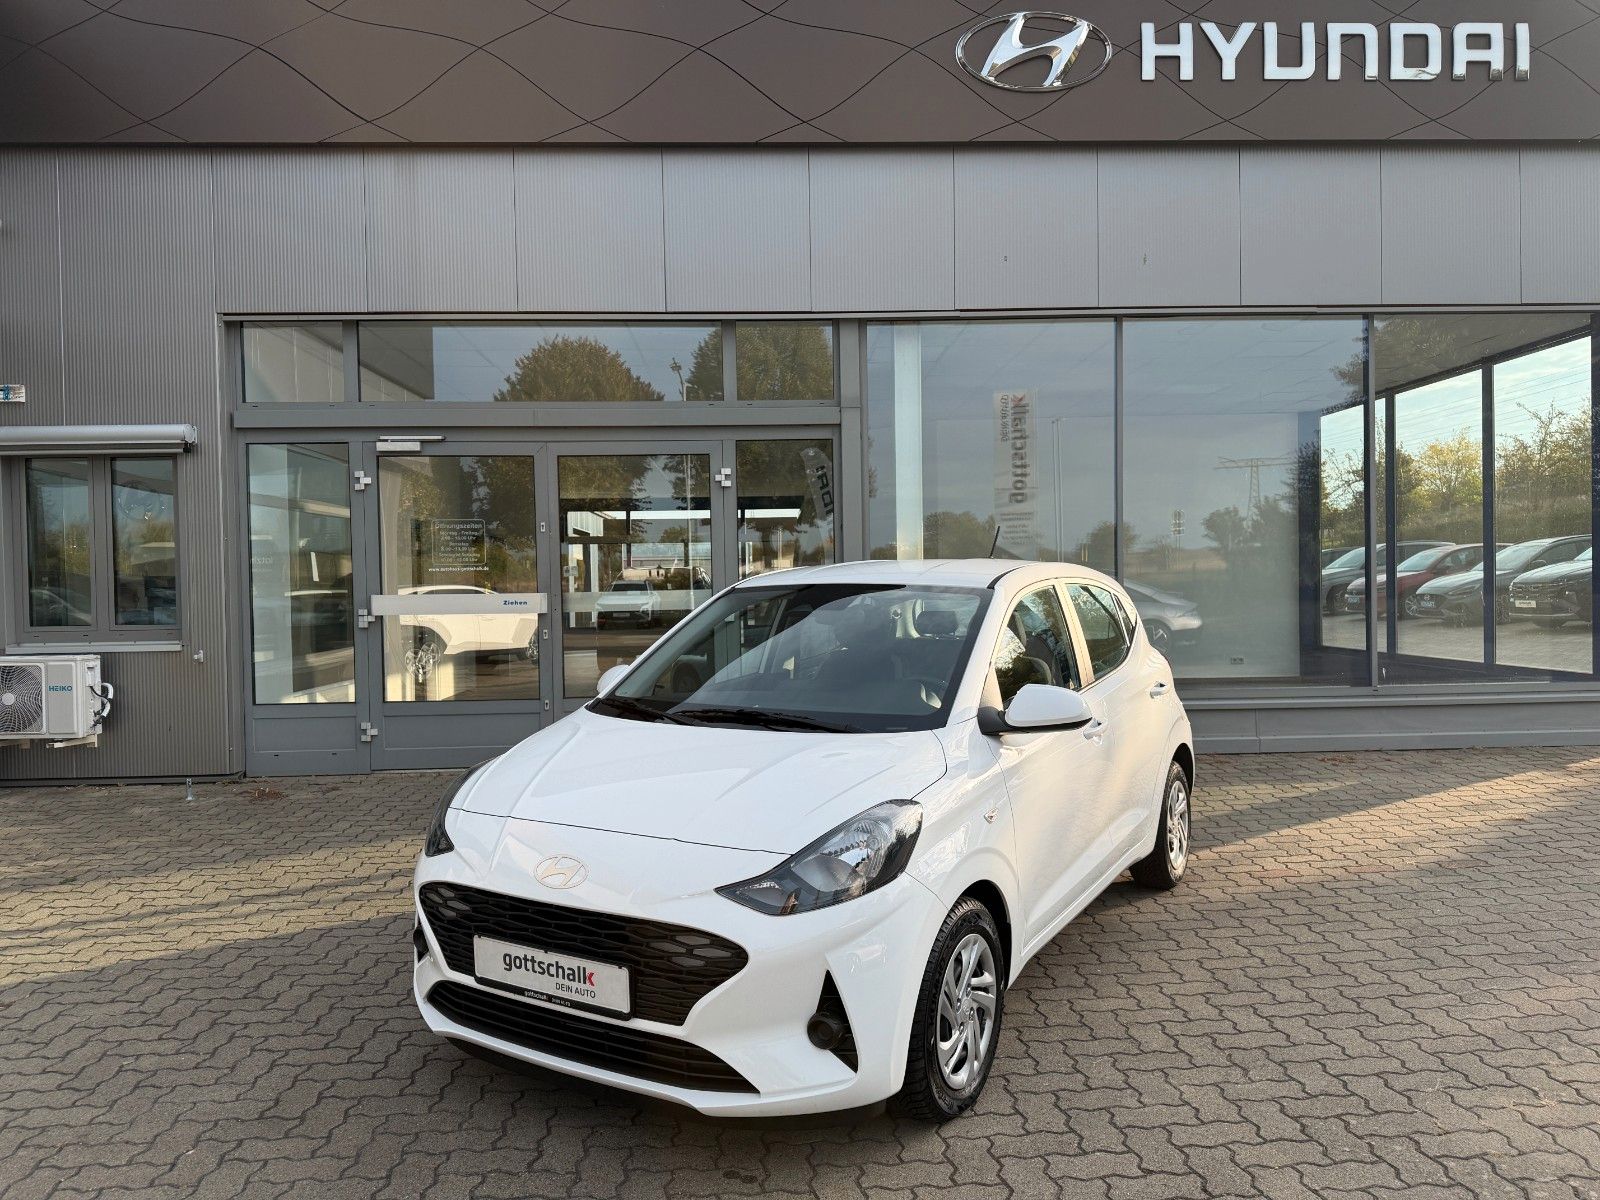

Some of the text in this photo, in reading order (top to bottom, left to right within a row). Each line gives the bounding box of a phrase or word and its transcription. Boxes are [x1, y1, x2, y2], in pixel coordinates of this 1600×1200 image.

[1140, 22, 1531, 81] HYUNDAI
[503, 952, 596, 987] gottschalk
[555, 982, 597, 999] DEIN AUTO
